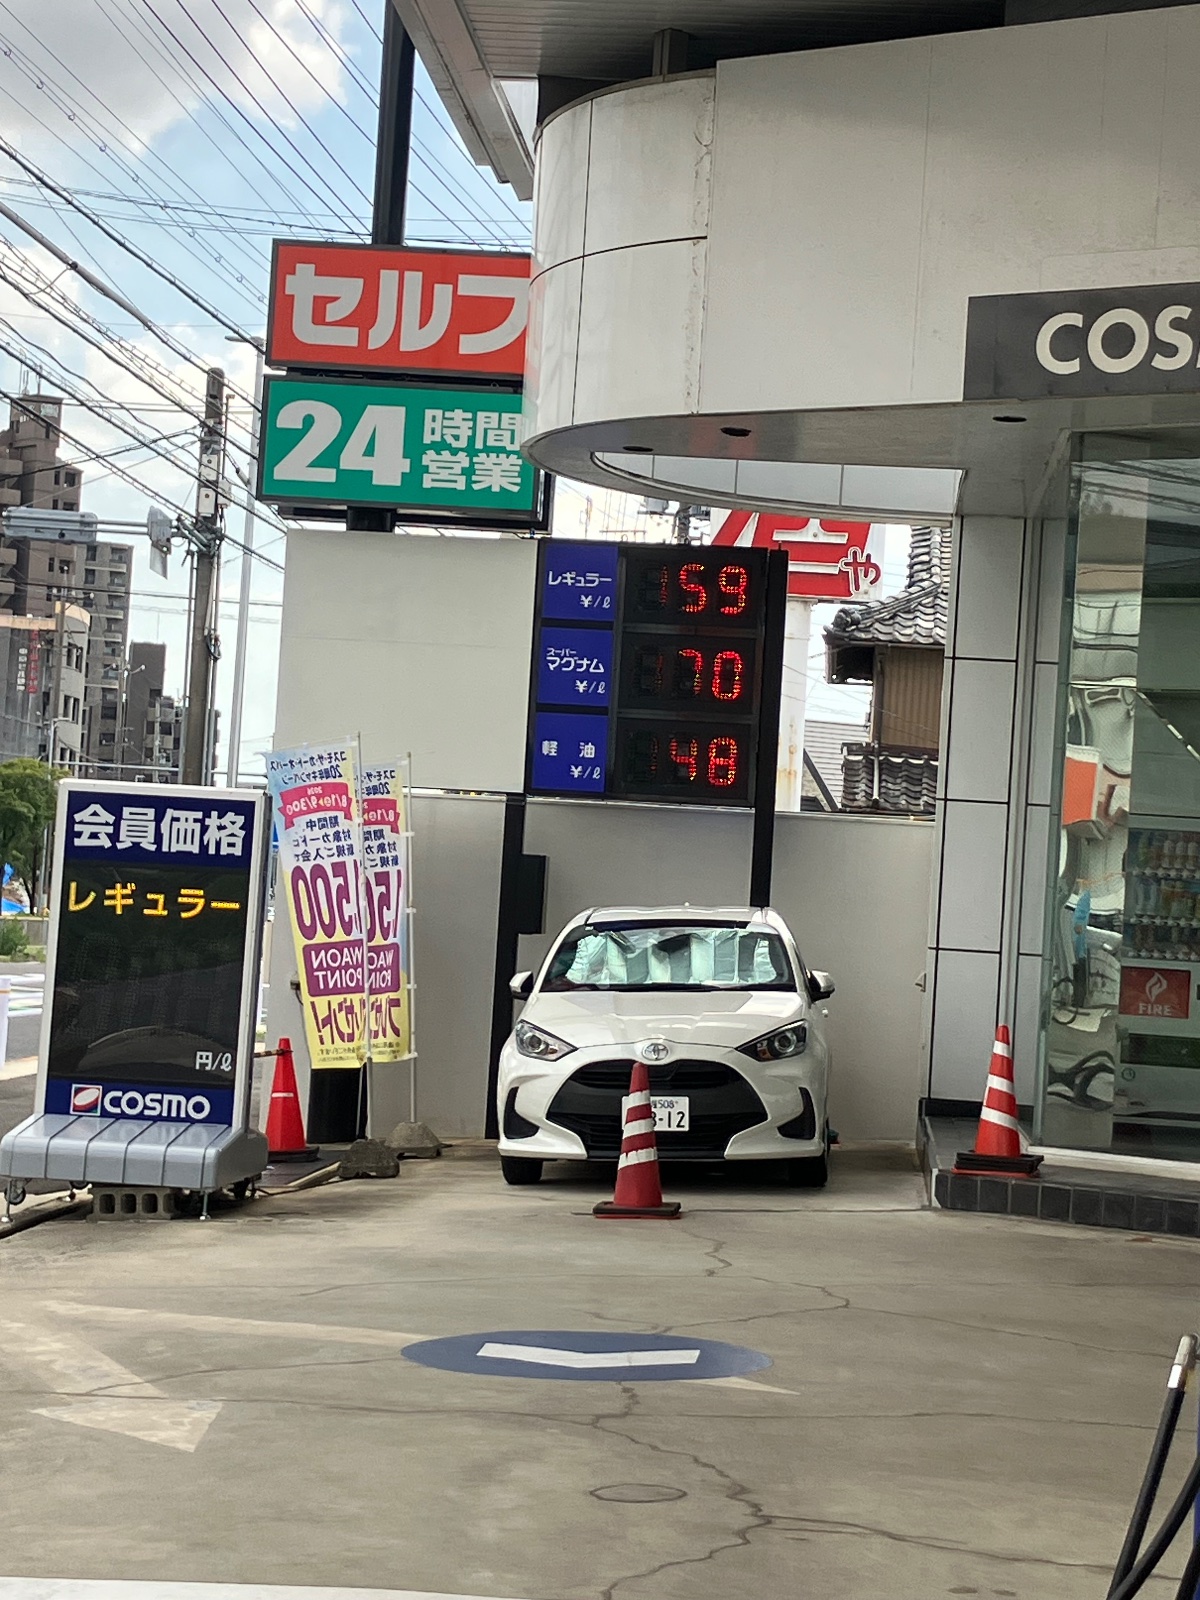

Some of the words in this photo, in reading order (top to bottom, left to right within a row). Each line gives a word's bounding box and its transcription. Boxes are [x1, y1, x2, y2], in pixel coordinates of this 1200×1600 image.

[285, 263, 531, 354] セルフ
[1036, 305, 1200, 375] COS
[273, 399, 411, 487] 24
[422, 408, 522, 450] 時間
[421, 449, 523, 493] 営業
[548, 570, 612, 588] レギュラー
[660, 562, 747, 615] 159
[546, 647, 577, 656] スーパー
[546, 656, 605, 673] マグナム
[654, 648, 744, 701] 170
[651, 736, 738, 786] 148
[72, 803, 247, 857] 会員価格
[67, 880, 241, 919] レギュラー
[1138, 1002, 1173, 1017] FIRE
[103, 1089, 211, 1121] COSMO
